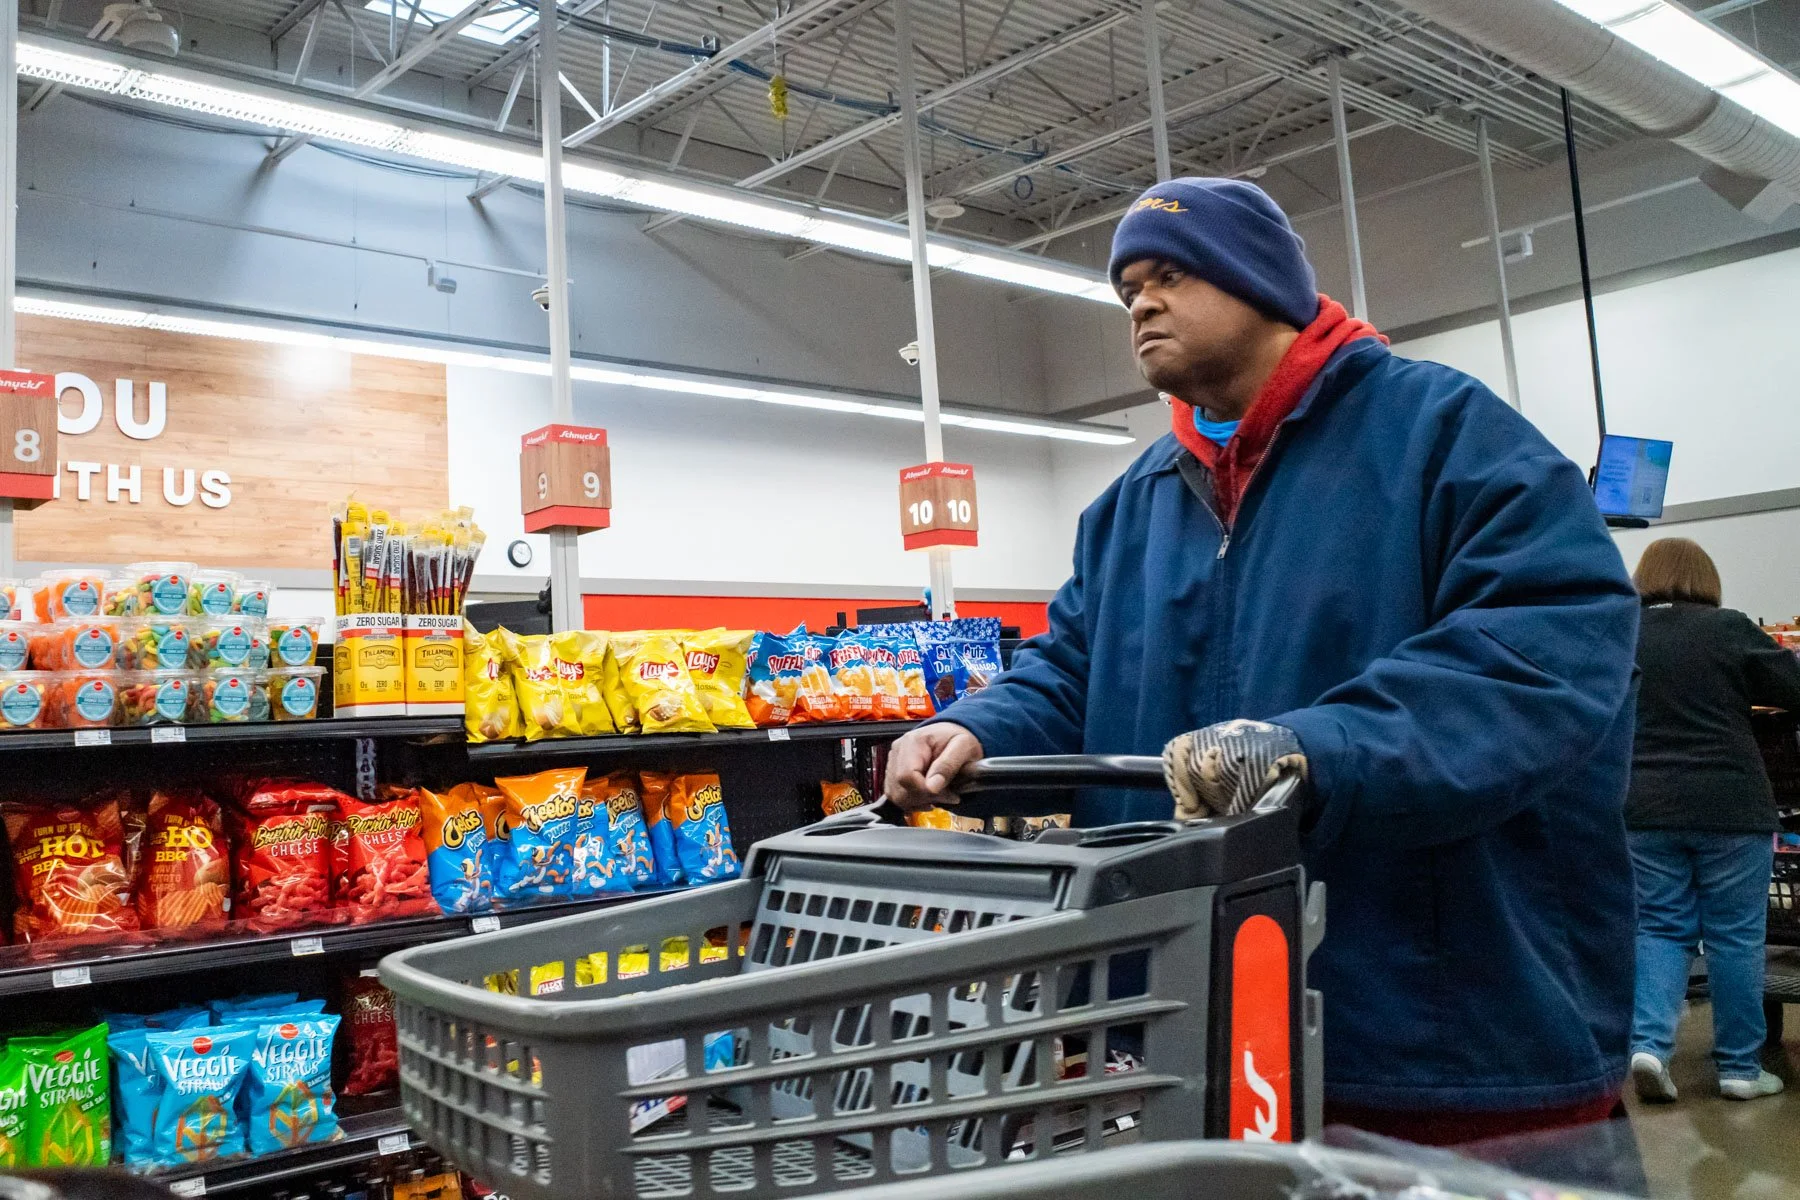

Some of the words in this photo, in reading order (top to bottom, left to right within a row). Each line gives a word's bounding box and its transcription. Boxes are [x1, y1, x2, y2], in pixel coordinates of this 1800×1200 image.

[14, 368, 167, 440] OU
[14, 429, 41, 462] 8
[53, 460, 141, 503] ITH
[163, 467, 232, 508] US
[537, 472, 548, 500] 9
[583, 472, 600, 499] 9
[908, 500, 933, 526] 10
[947, 499, 971, 523] 10
[356, 616, 375, 627] ZERO
[377, 616, 400, 626] SUGAR
[418, 617, 436, 627] ZERO
[437, 618, 458, 628] SUGAR
[769, 655, 804, 675] RUFFLE
[40, 835, 105, 859] HOT
[155, 851, 188, 862] BBQ
[271, 841, 319, 857] CHEESE
[252, 1031, 329, 1068] VEGGIE
[28, 1048, 102, 1094] VEGGIE
[162, 1045, 241, 1083] VEGGIE
[40, 1083, 95, 1109] STRAWS
